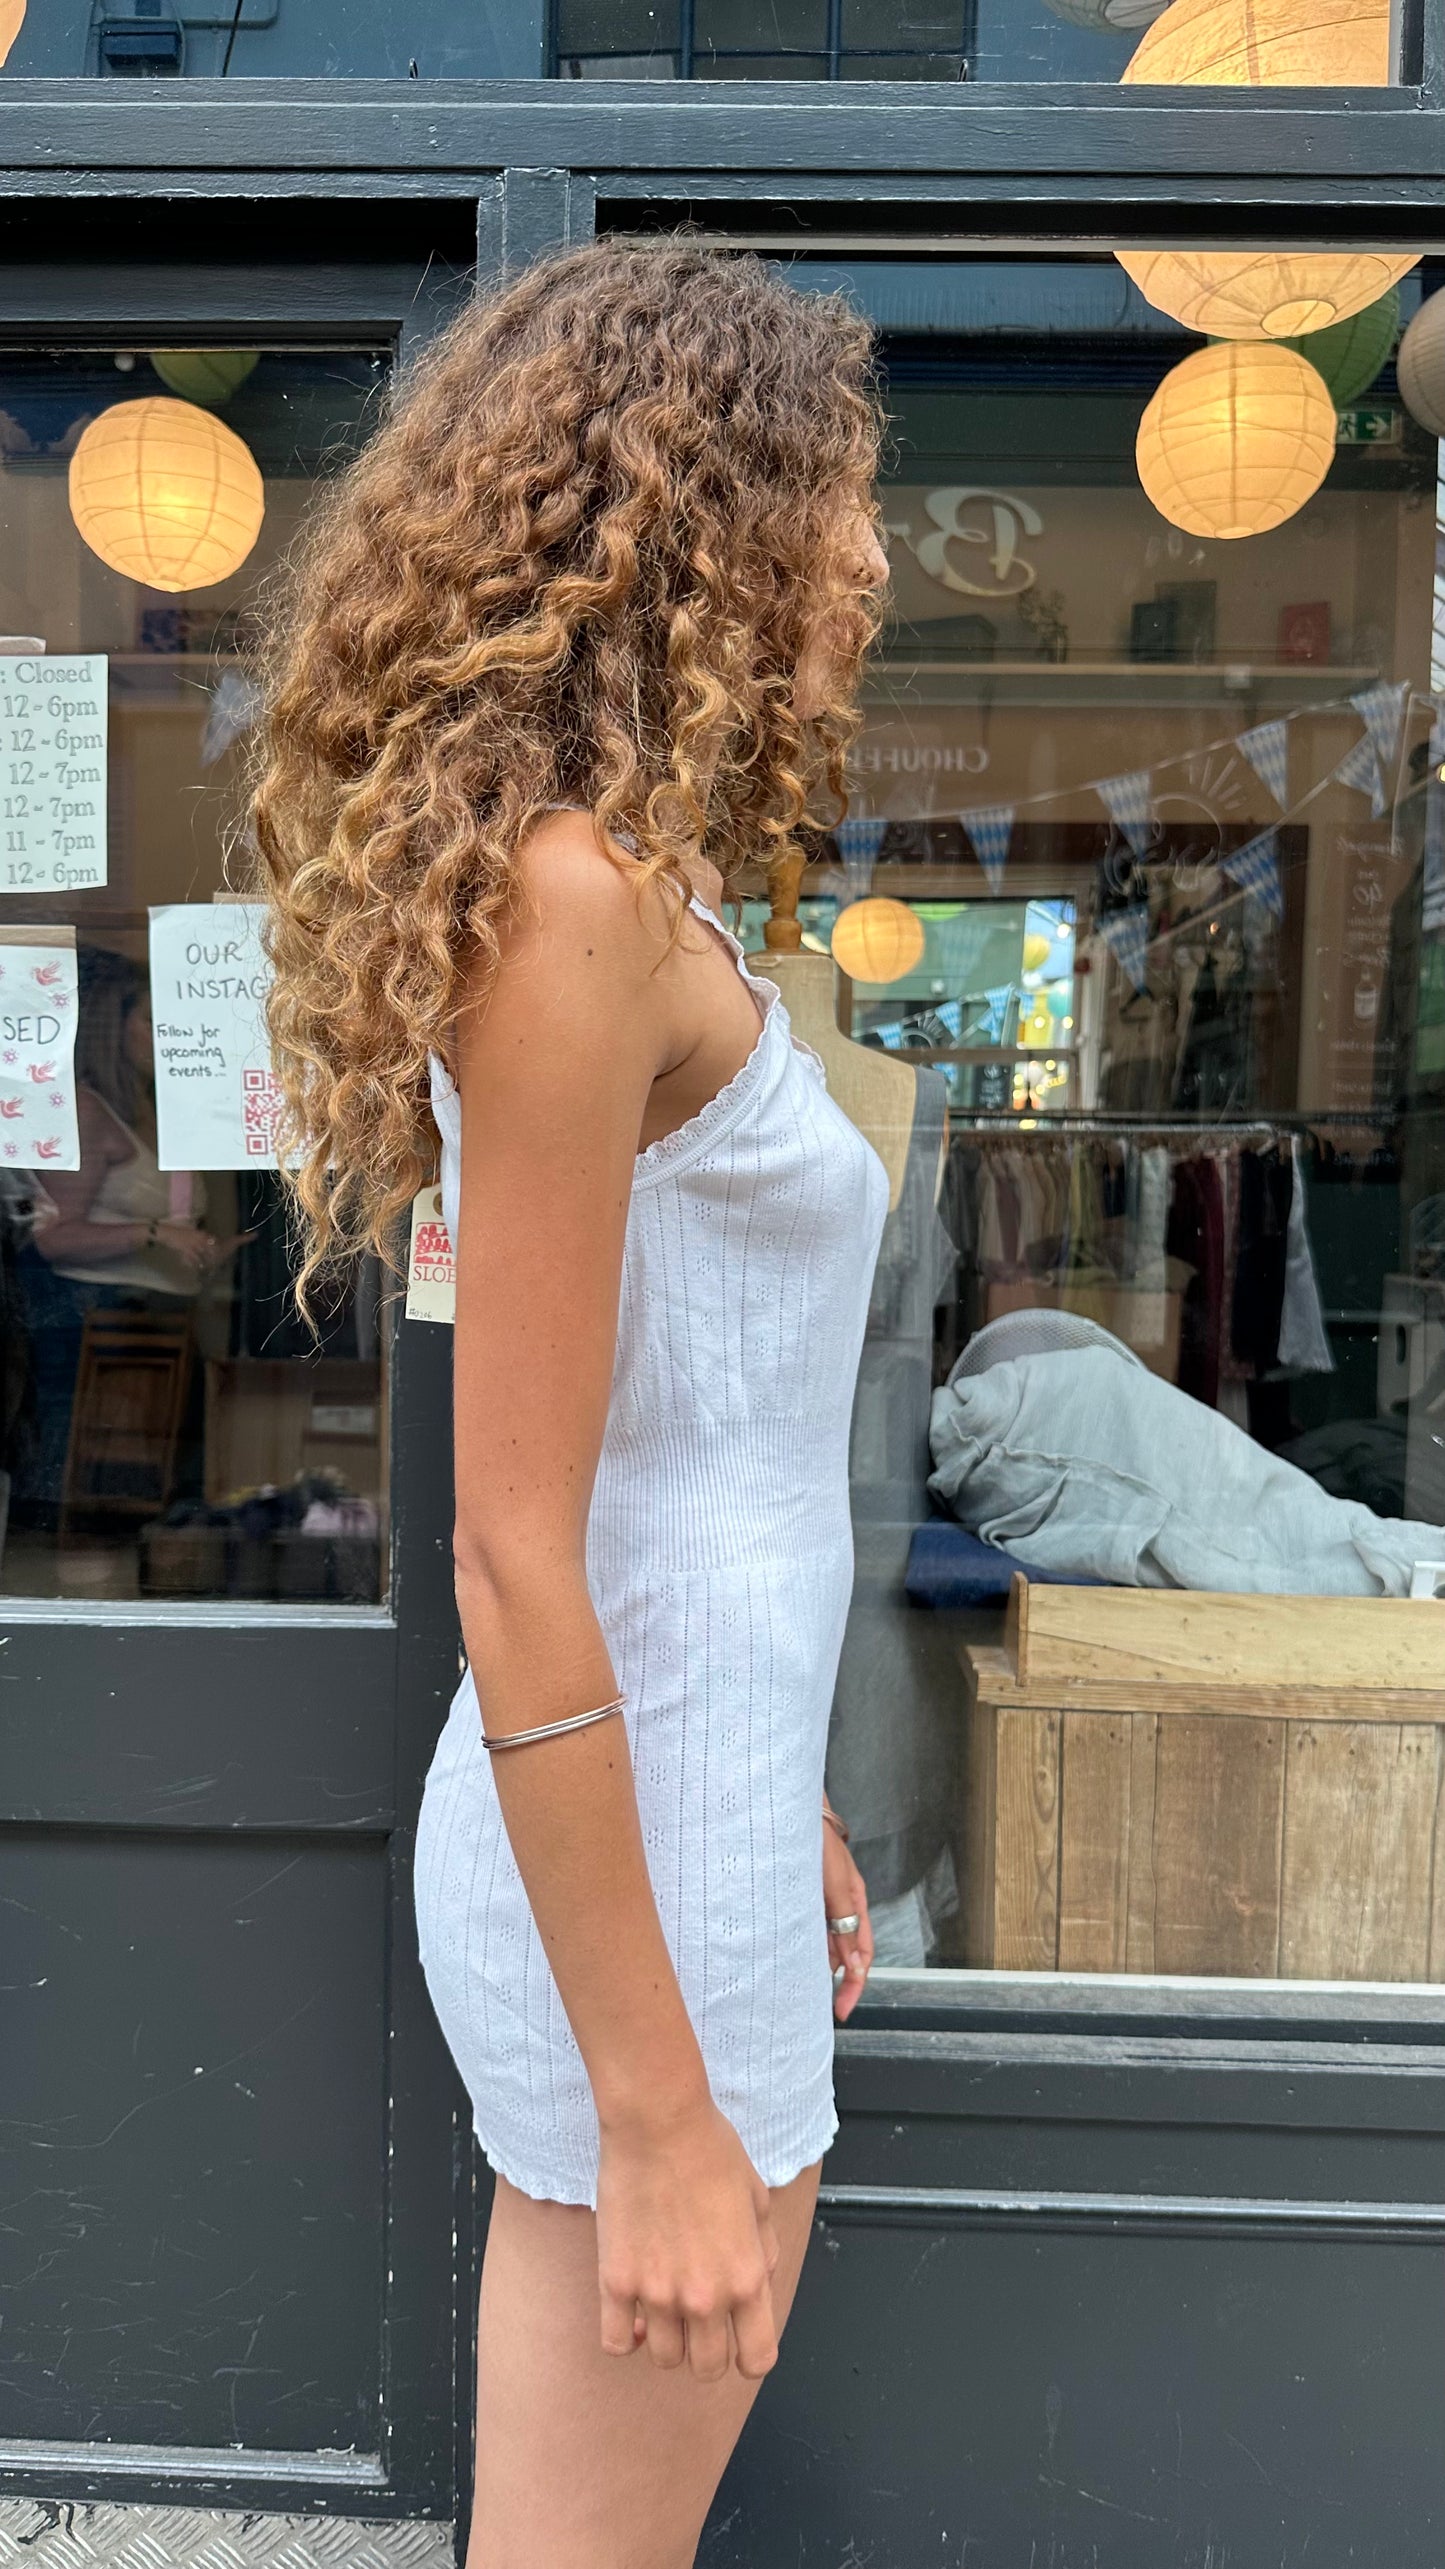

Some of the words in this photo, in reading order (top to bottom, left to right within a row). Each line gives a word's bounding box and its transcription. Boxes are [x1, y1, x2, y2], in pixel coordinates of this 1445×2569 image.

[15, 661, 93, 684] Closed
[4, 694, 30, 718] 12
[48, 695, 98, 723] 6pm
[10, 728, 36, 751] 12
[55, 728, 104, 756] 6pm
[9, 761, 35, 785] 12
[54, 761, 101, 790] 7pm
[4, 795, 29, 818] 12
[50, 797, 96, 824] 7pm
[6, 831, 27, 851] 11
[52, 830, 96, 856] 7pm
[7, 863, 33, 885] 12
[53, 863, 98, 889] 6pm
[186, 941, 243, 965] OUR
[3, 1015, 61, 1045] SED
[157, 1023, 193, 1038] Follow
[198, 1023, 221, 1048] for
[161, 1047, 226, 1068] upcoming
